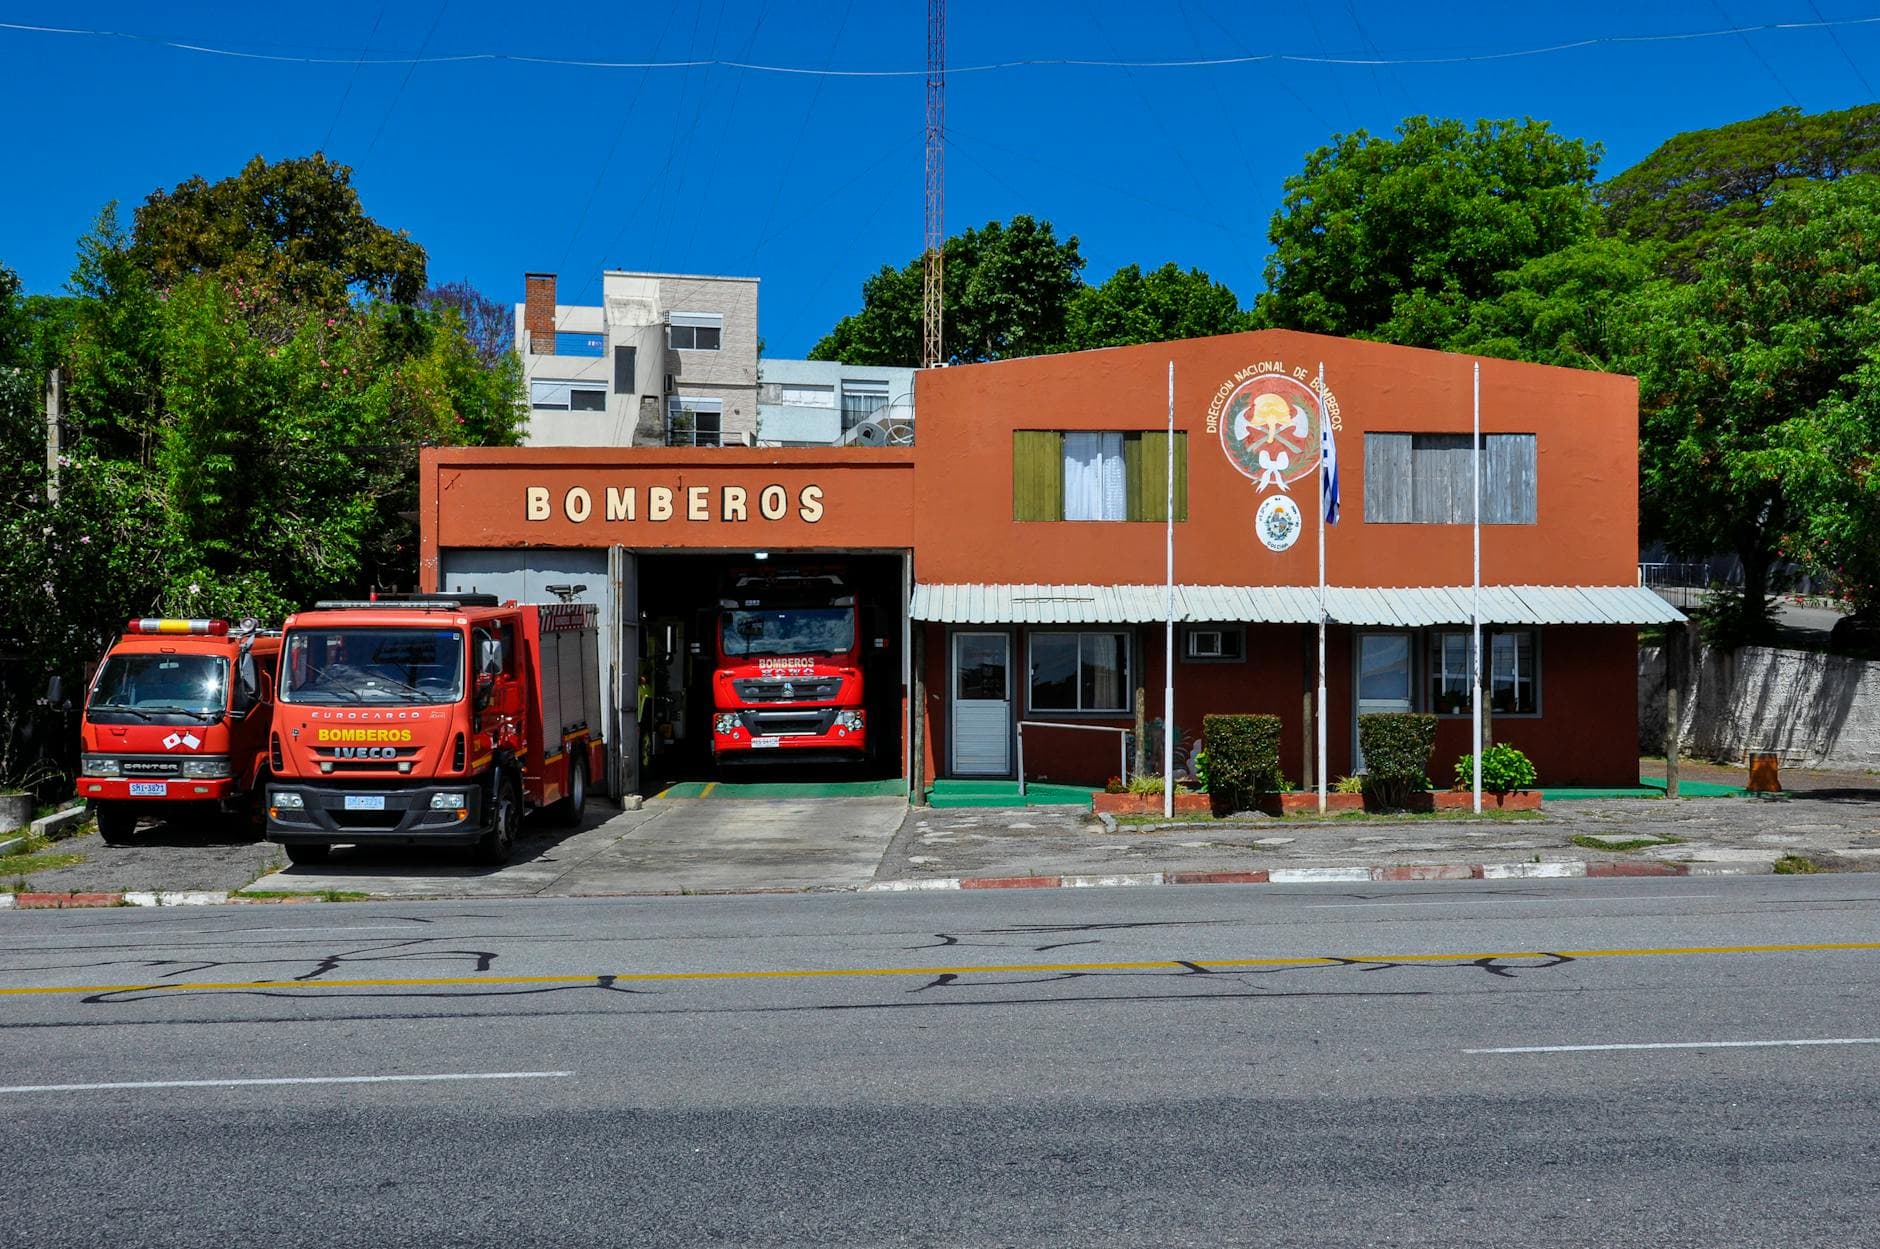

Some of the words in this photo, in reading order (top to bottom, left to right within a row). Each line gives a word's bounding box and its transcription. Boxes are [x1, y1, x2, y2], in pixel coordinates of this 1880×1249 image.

[1234, 361, 1286, 382] NACIONAL
[1293, 366, 1308, 380] DE
[526, 484, 824, 524] BOMBEROS
[759, 657, 815, 669] BOMBEROS
[311, 711, 420, 720] EUROCARGO
[318, 729, 412, 741] BOMBEROS
[334, 747, 397, 759] IVECO
